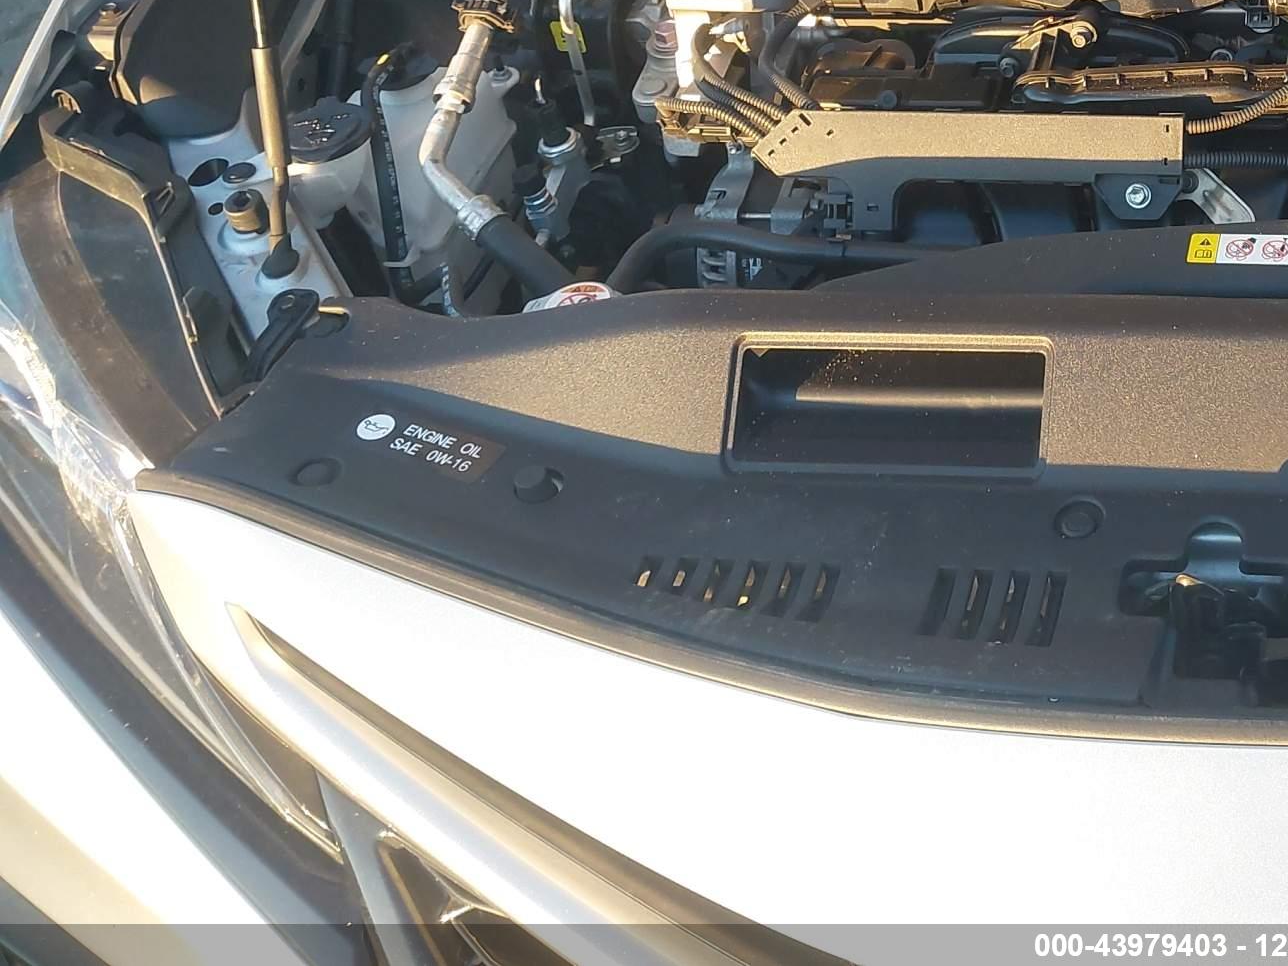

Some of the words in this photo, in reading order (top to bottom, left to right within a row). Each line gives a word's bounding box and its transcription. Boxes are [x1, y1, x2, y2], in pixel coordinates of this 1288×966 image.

[390, 438, 422, 456] SAE
[426, 450, 472, 472] 0W-16
[404, 424, 457, 448] ENGINE
[460, 443, 481, 458] OIL
